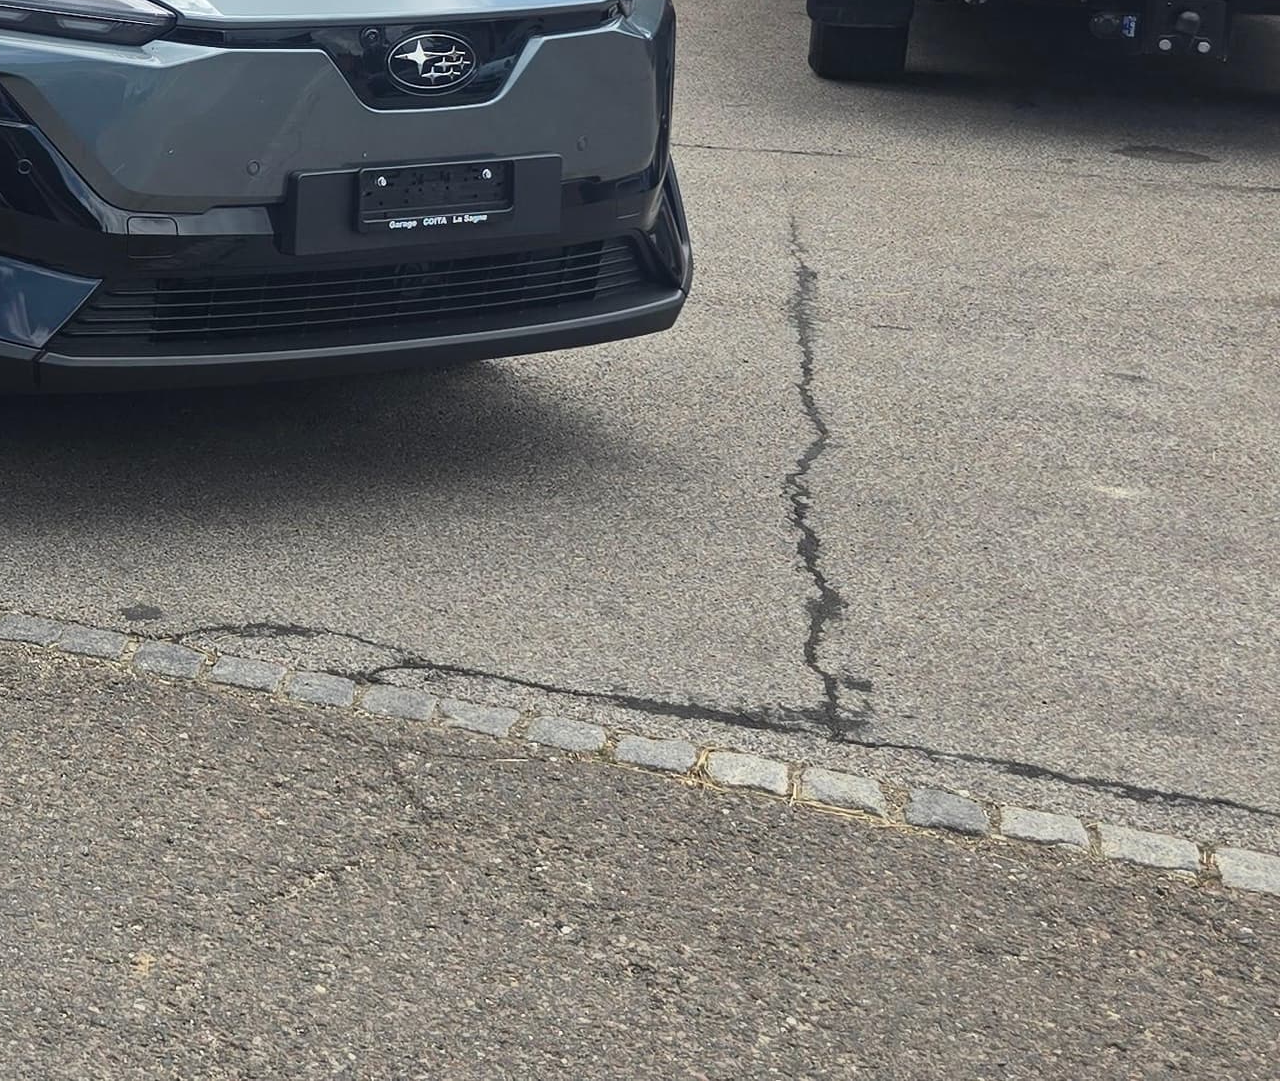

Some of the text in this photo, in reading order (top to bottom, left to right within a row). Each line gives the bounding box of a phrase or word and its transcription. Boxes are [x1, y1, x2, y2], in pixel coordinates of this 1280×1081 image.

[389, 220, 417, 229] Garage
[423, 216, 447, 226] COITA
[452, 215, 462, 223] La
